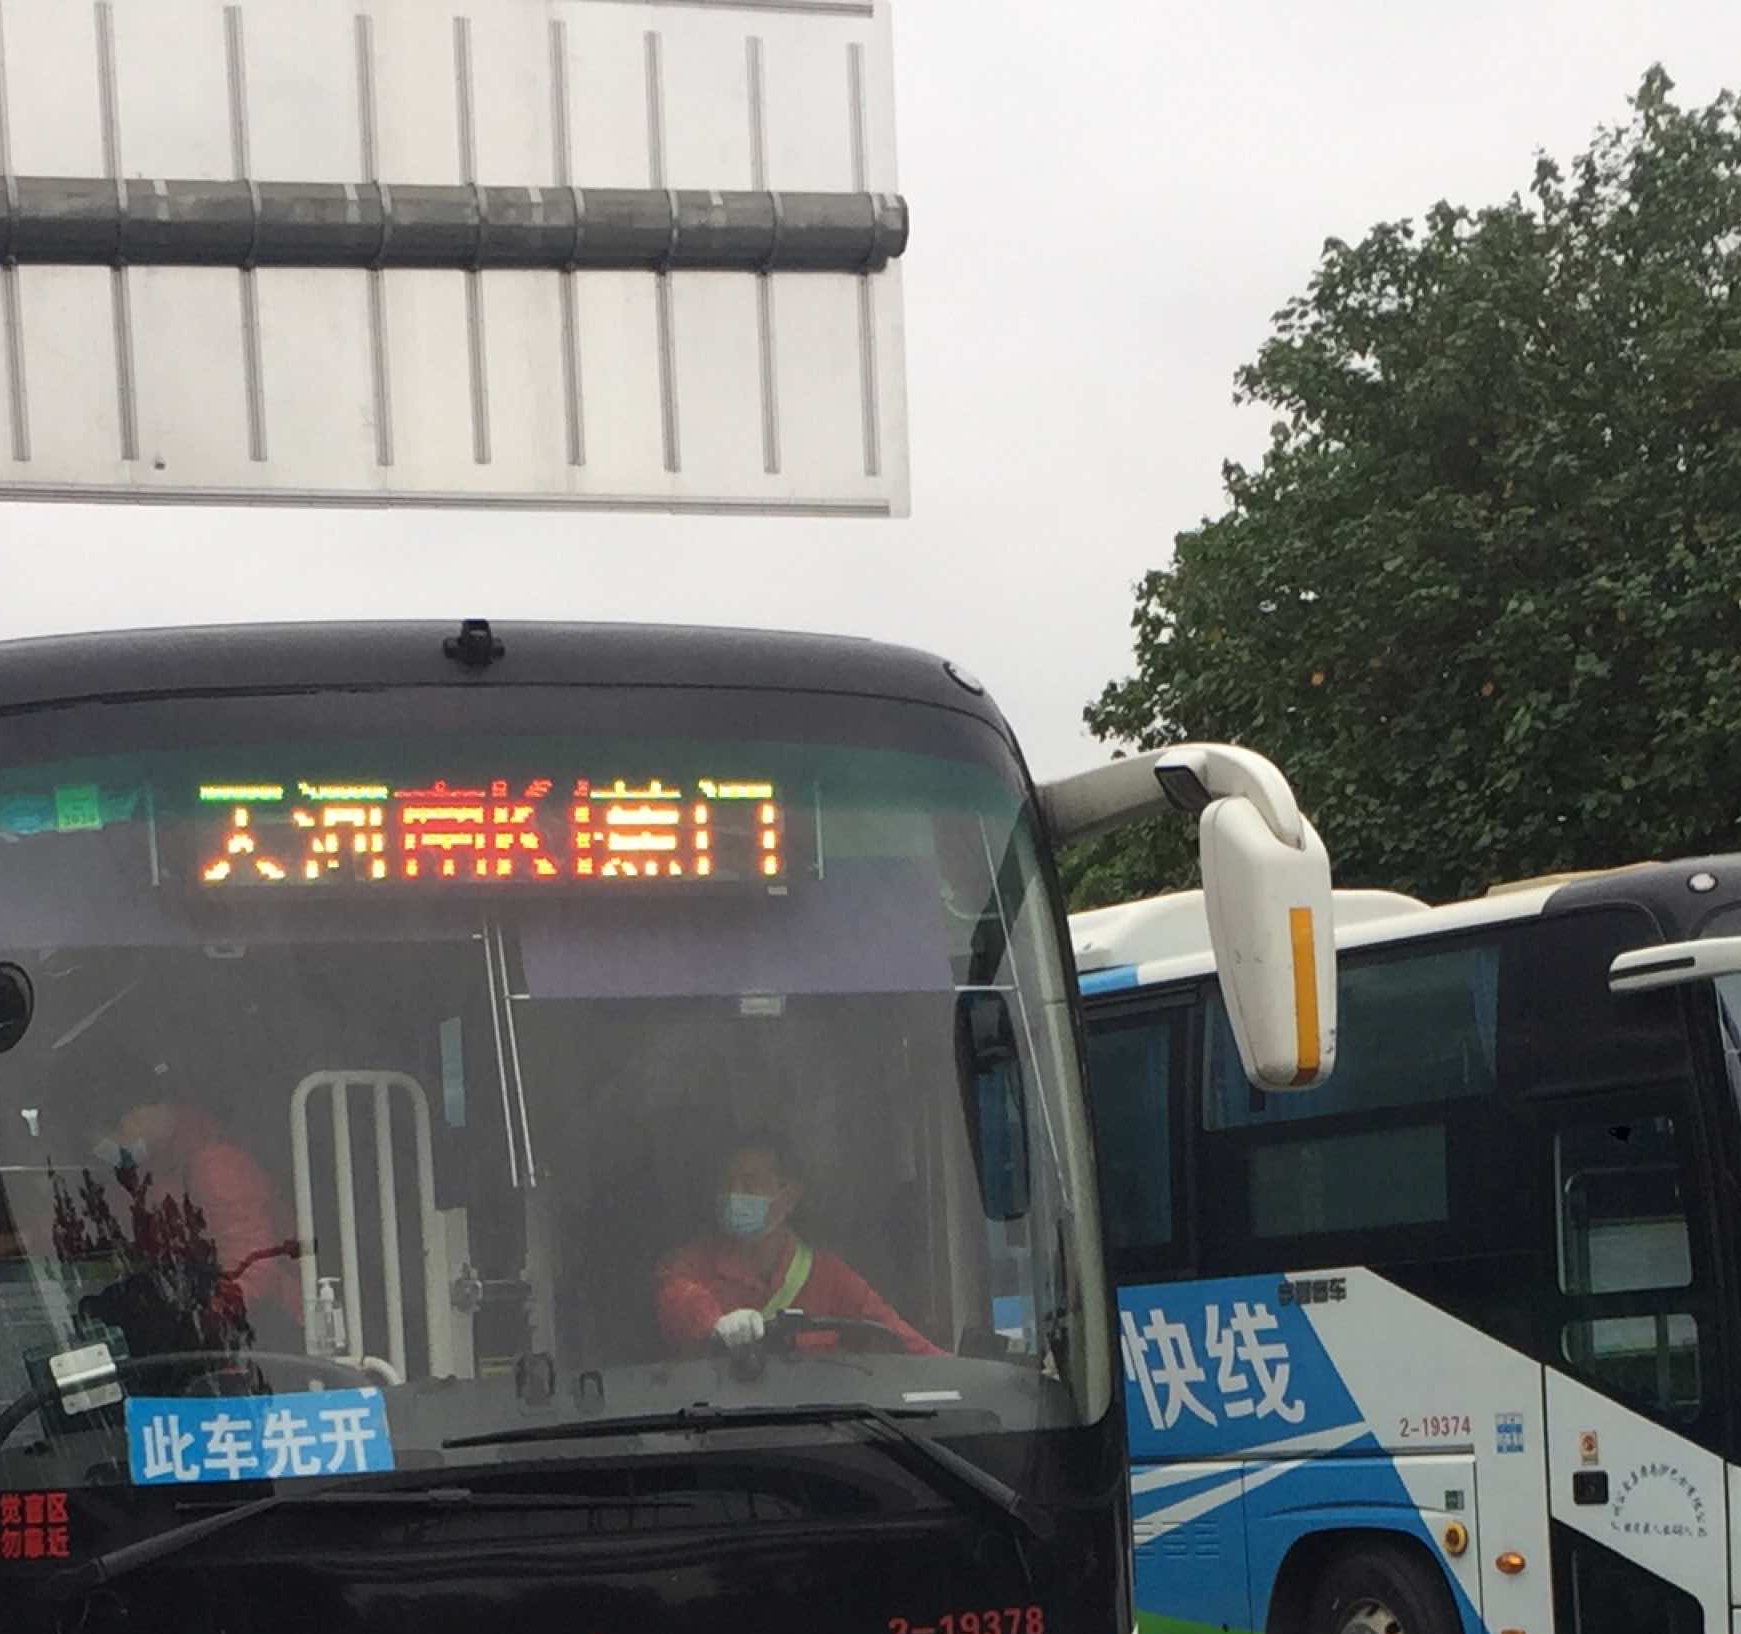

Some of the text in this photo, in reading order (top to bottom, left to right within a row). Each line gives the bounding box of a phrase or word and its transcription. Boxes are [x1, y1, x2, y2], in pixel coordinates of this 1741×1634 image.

[1121, 1302, 1306, 1431] 快线
[140, 1404, 381, 1483] 此车先开
[1399, 1416, 1471, 1438] 2-19374
